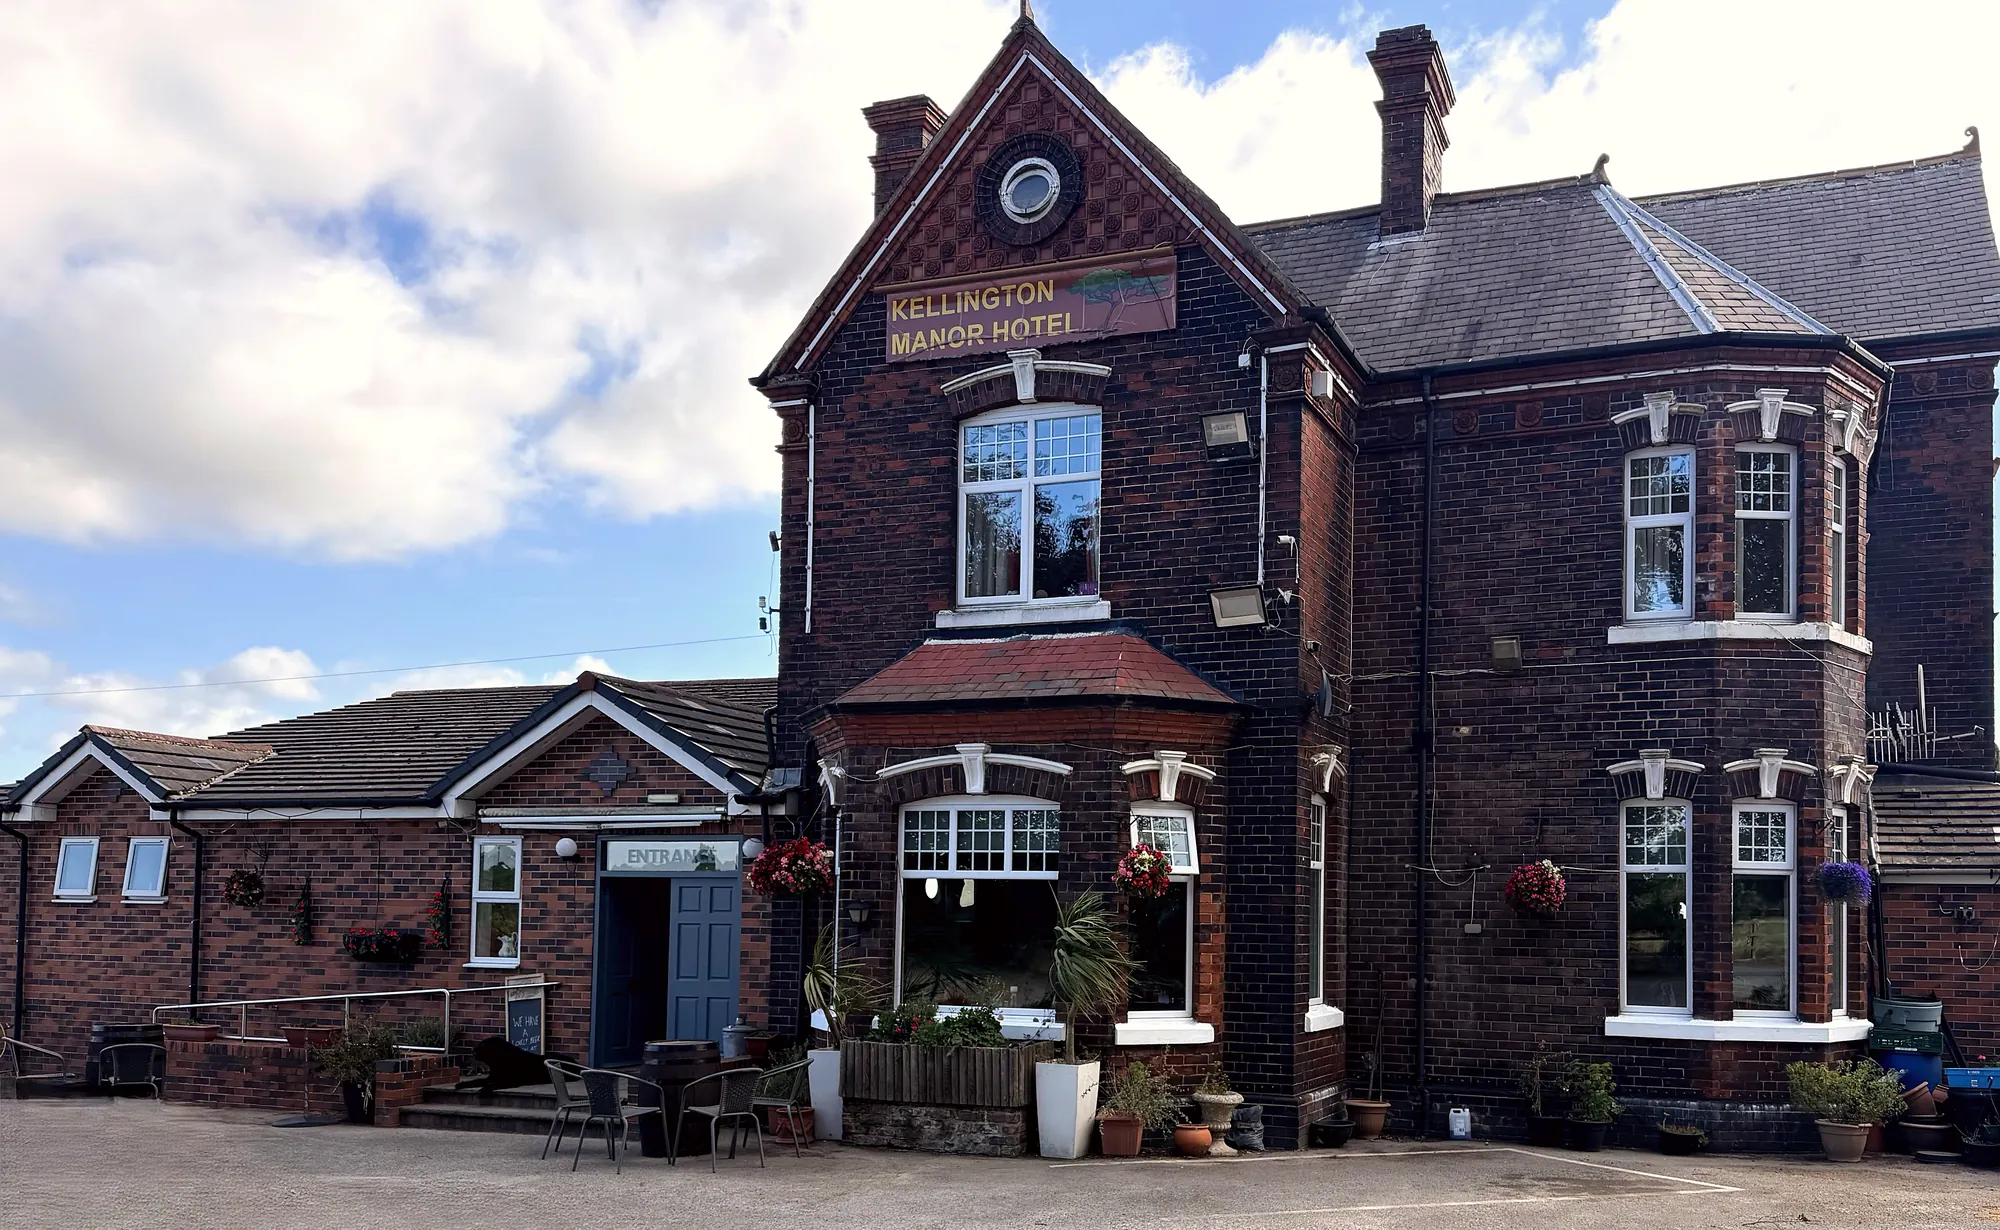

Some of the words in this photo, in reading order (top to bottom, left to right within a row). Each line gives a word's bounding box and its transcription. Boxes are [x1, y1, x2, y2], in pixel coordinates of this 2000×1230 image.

[892, 279, 1054, 321] KELLINGTON
[891, 323, 984, 355] MANOR
[992, 312, 1074, 342] HOTEL
[512, 1016, 523, 1027] WE
[525, 1015, 539, 1026] HAVE
[522, 1028, 528, 1038] A
